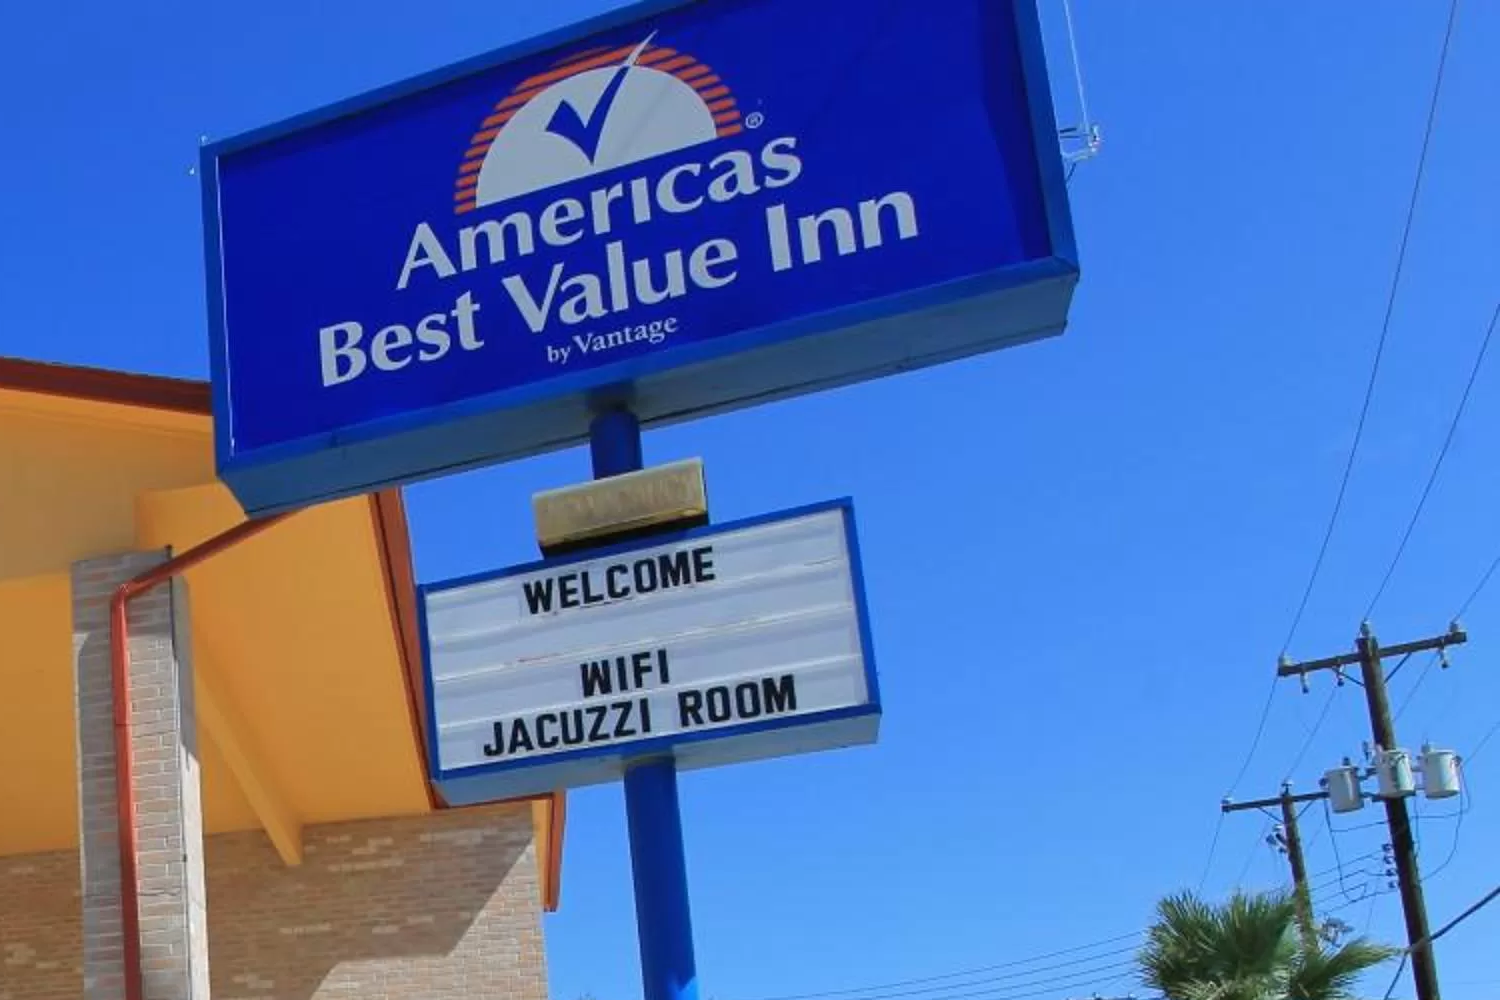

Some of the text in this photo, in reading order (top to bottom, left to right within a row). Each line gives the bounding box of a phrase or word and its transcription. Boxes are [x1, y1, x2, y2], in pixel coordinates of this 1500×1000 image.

[396, 136, 803, 290] Americas
[319, 191, 919, 388] Best Value Inn
[547, 317, 678, 364] by Vantage
[523, 546, 716, 615] WELCOME
[580, 648, 671, 698] WIFI
[484, 674, 797, 757] JACUZZI ROOM
